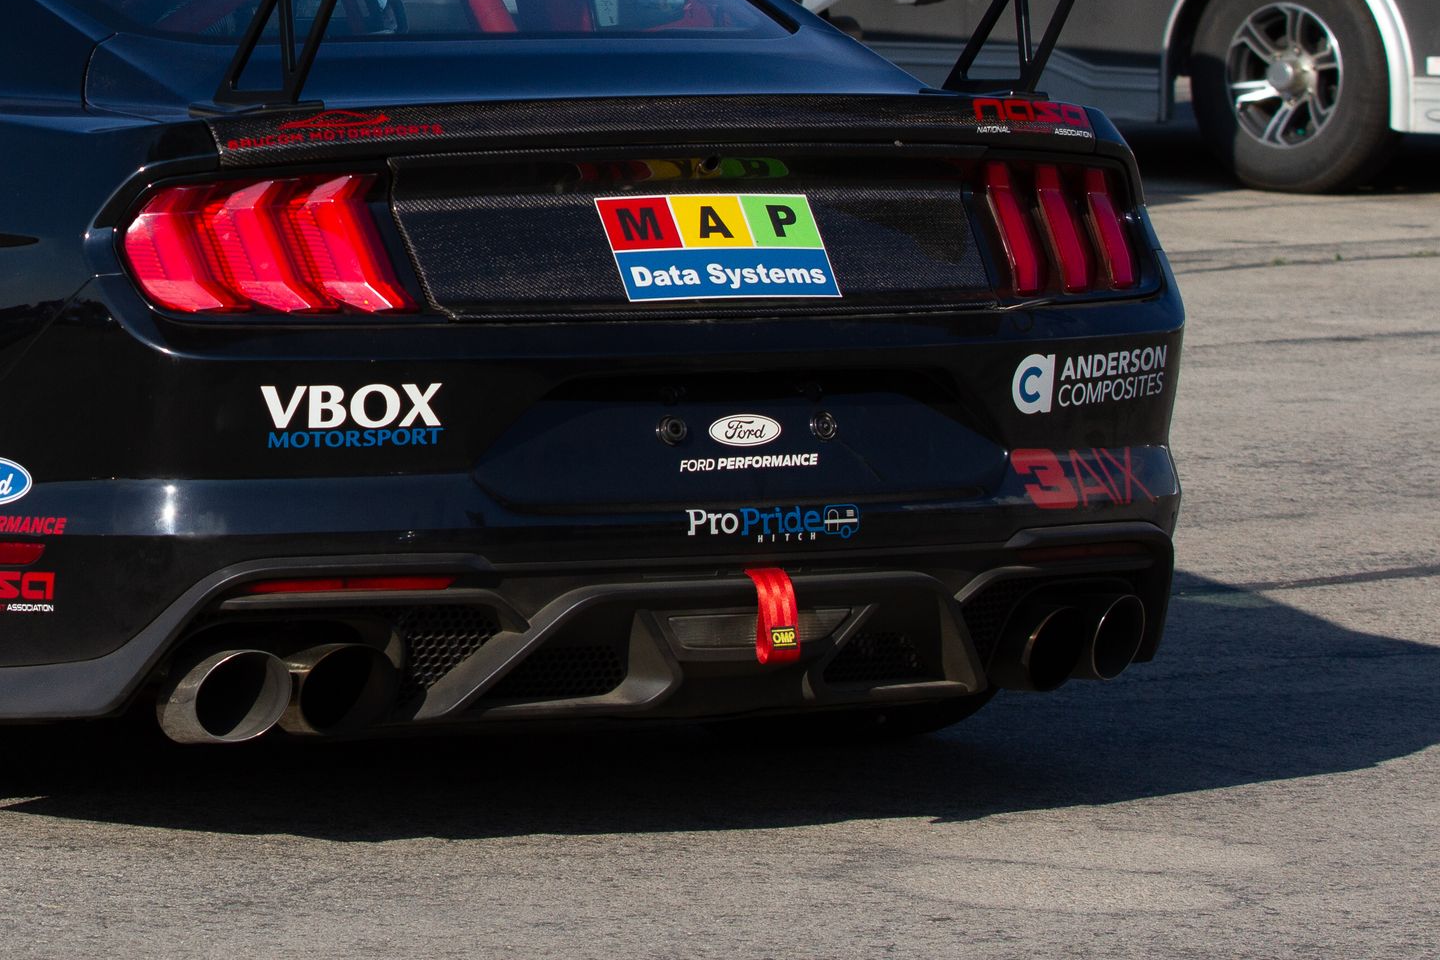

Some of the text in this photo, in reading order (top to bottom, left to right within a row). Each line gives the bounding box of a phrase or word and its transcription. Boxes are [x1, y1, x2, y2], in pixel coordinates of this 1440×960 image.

[310, 123, 445, 141] MOTORSPORTS
[630, 263, 827, 289] Data Systems
[1060, 344, 1168, 381] ANDERSON
[1058, 372, 1165, 407] COMPOSITES
[260, 382, 443, 429] VBOX
[268, 427, 444, 449] MOTORSPORT
[724, 419, 766, 440] Ford
[679, 452, 819, 473] FORD PERFORMANCE
[685, 505, 821, 537] ProPride
[757, 531, 817, 543] HITCH
[6, 603, 55, 613] ASSOCIATION
[772, 631, 796, 645] OMP
